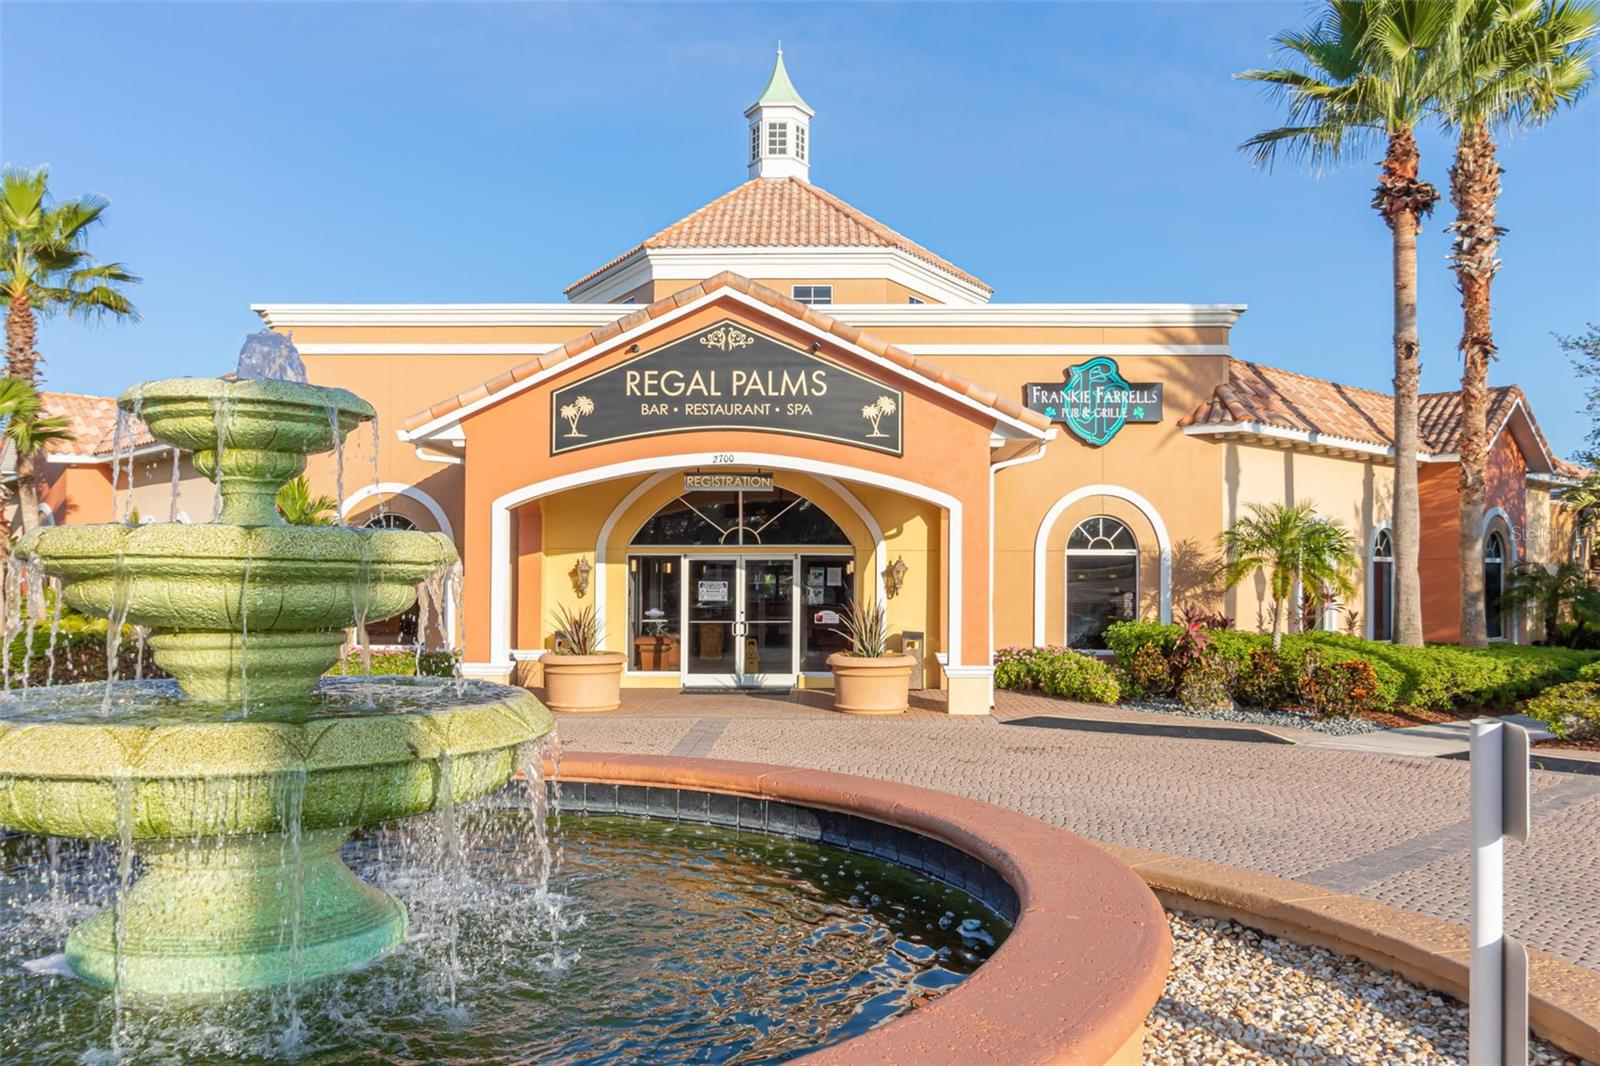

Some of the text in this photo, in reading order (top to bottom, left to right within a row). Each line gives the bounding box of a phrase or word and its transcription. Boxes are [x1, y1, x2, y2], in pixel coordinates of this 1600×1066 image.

[626, 369, 828, 397] REGAL PALMS
[1032, 386, 1158, 404] FRANKIE FARRELLS
[641, 403, 813, 416] BAR RESTAURANT SPA
[1061, 406, 1128, 418] PUB & GRILLE
[712, 454, 735, 464] 2700
[686, 476, 771, 488] REGISTRATION
